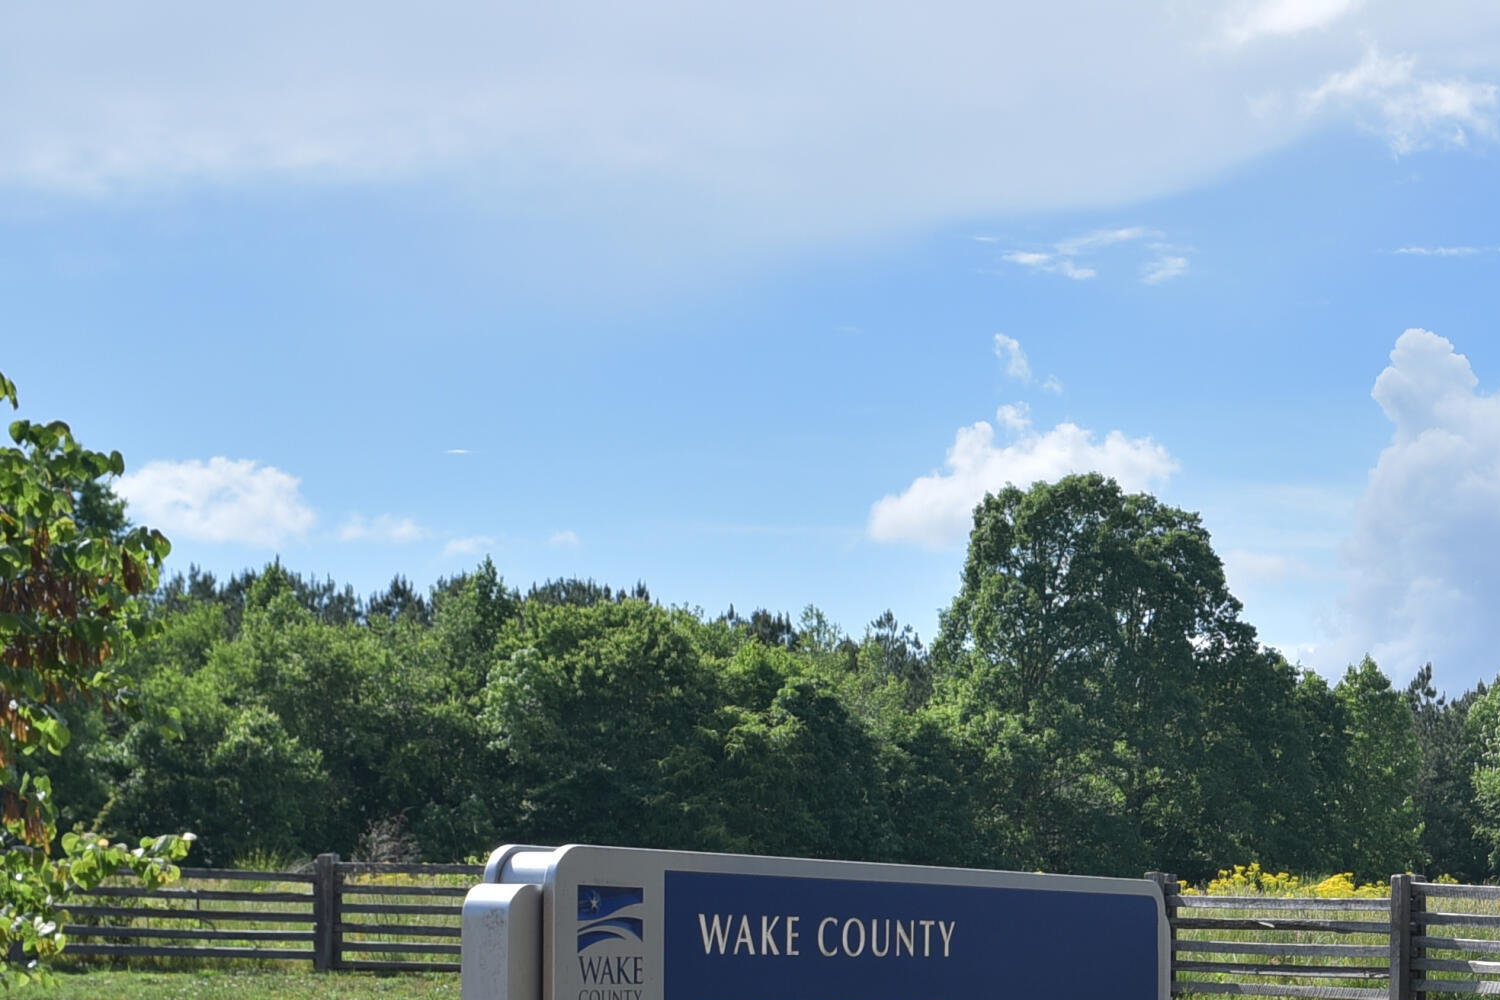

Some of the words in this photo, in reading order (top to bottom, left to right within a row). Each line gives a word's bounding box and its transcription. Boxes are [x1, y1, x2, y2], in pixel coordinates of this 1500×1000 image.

[698, 913, 801, 957] WAKE
[817, 917, 956, 958] COUNTY
[577, 955, 644, 985] WAKE
